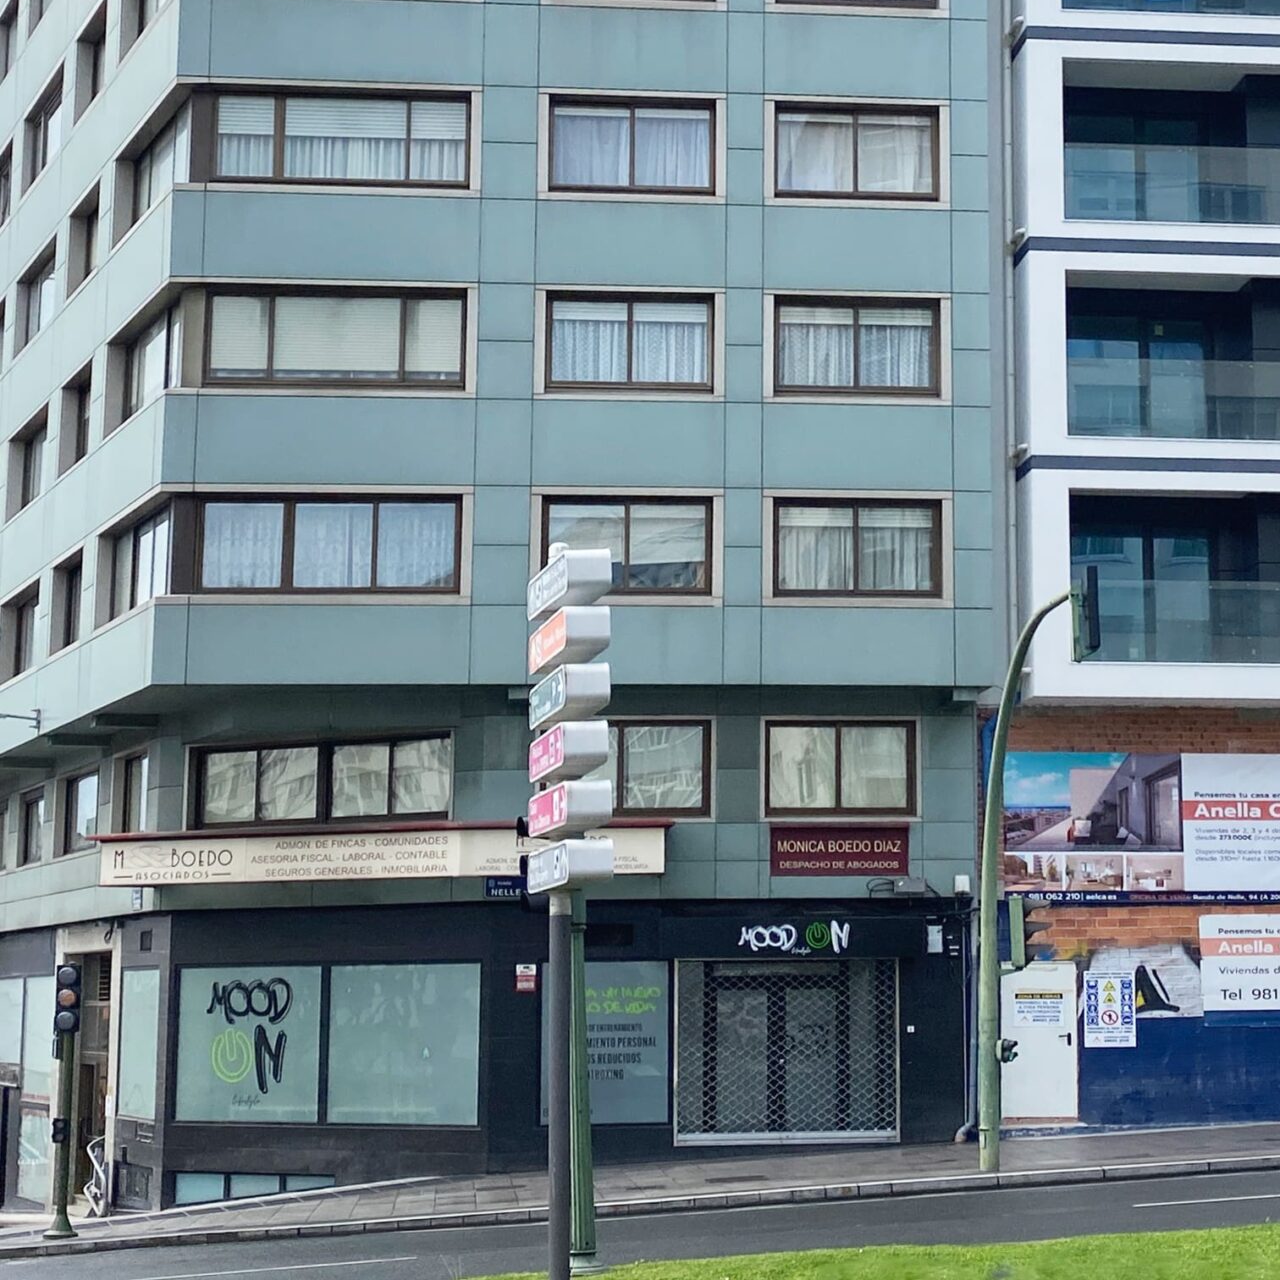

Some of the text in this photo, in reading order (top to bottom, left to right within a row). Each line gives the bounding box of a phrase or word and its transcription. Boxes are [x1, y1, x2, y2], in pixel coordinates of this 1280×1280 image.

[1194, 791, 1236, 799] Pensemos
[1194, 802, 1262, 819] Anella
[315, 839, 329, 849] DE
[331, 838, 367, 849] FINCAS
[374, 835, 449, 847] COMUNIDADES
[777, 840, 901, 853] MONICA BOEDO DIAZ
[113, 847, 233, 870] M BOEDO
[251, 850, 447, 864] ASESORIA FISCAL LABORAL CONTABLE
[265, 864, 448, 878] SEGUROS GENERALES INMOBILIARIA
[779, 860, 900, 870] DESPACHO DE ABOGADOS
[135, 870, 210, 881] ASOCIADOS
[1045, 892, 1062, 900] 062
[1065, 892, 1081, 900] 210
[1218, 927, 1263, 935] Pensemos
[1265, 927, 1275, 935] tu
[738, 924, 798, 952] MOOD
[1218, 939, 1274, 954] Anella
[1219, 965, 1270, 975] Viviendas
[206, 977, 294, 1025] MOOD
[1251, 988, 1279, 1001] 981
[617, 1035, 657, 1048] PERSONAL
[597, 1052, 642, 1065] REDUCIDOS
